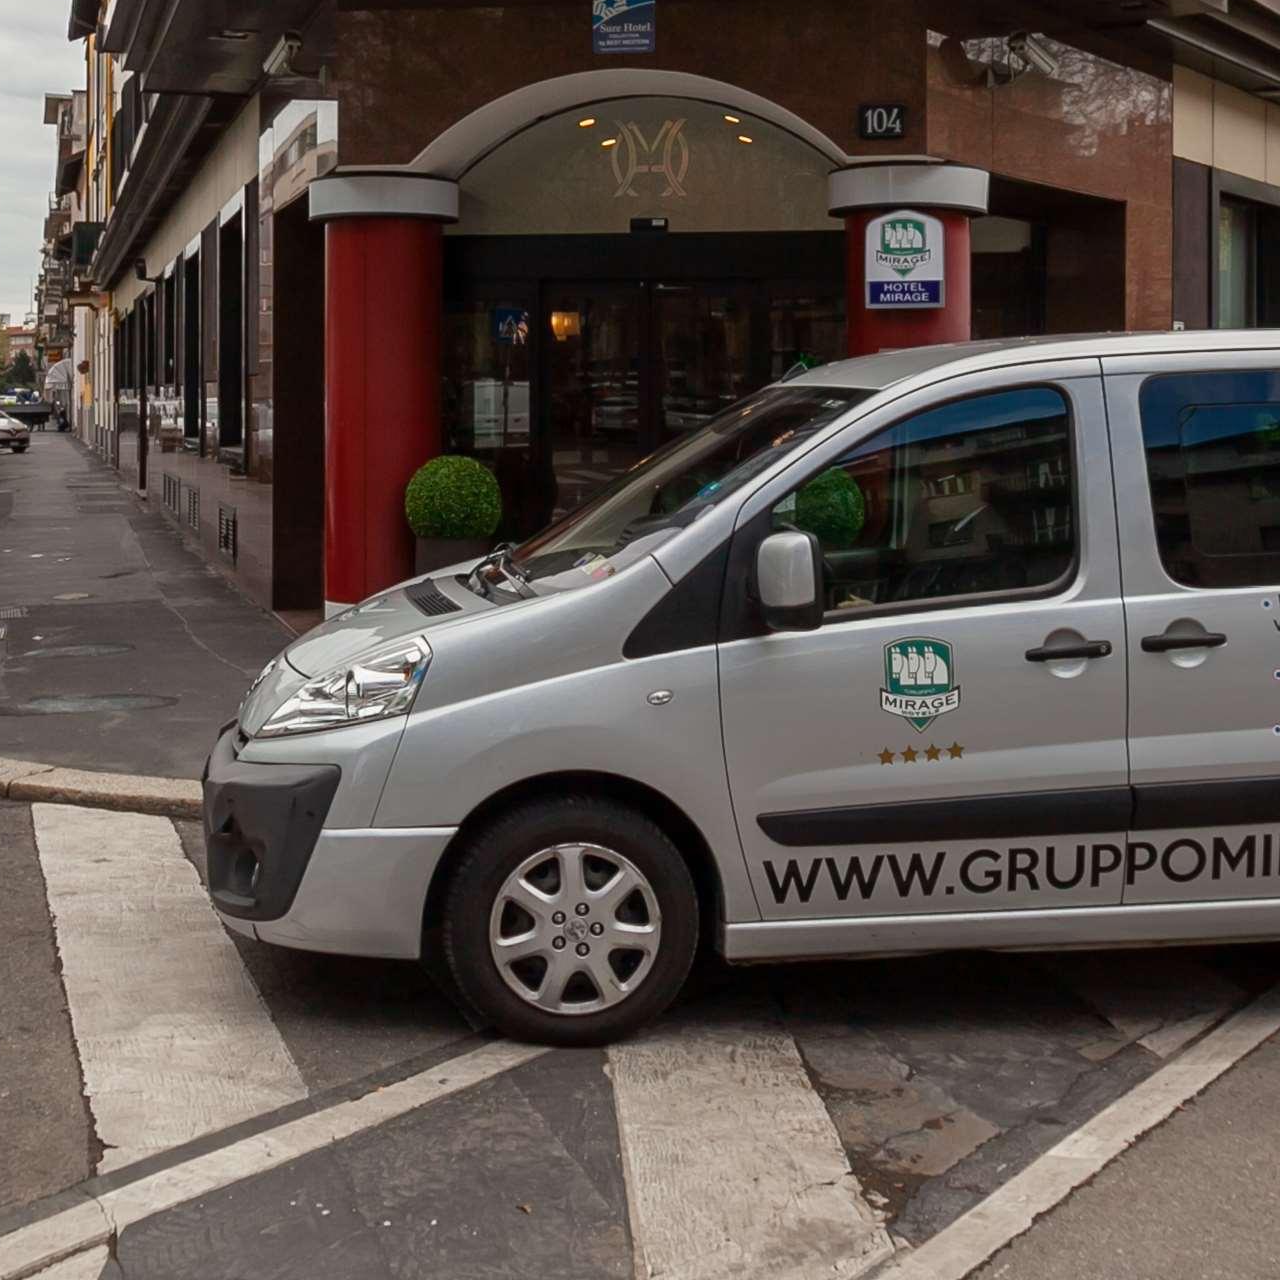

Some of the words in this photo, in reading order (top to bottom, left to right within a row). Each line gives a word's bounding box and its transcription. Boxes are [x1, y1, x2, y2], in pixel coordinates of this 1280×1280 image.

[600, 23, 622, 33] Sure
[624, 22, 651, 33] Hotel
[865, 108, 902, 133] 104
[879, 254, 927, 265] MIRAGE
[883, 282, 926, 292] HOTEL
[880, 292, 930, 302] MIRAGE
[884, 694, 957, 710] MIRAGE
